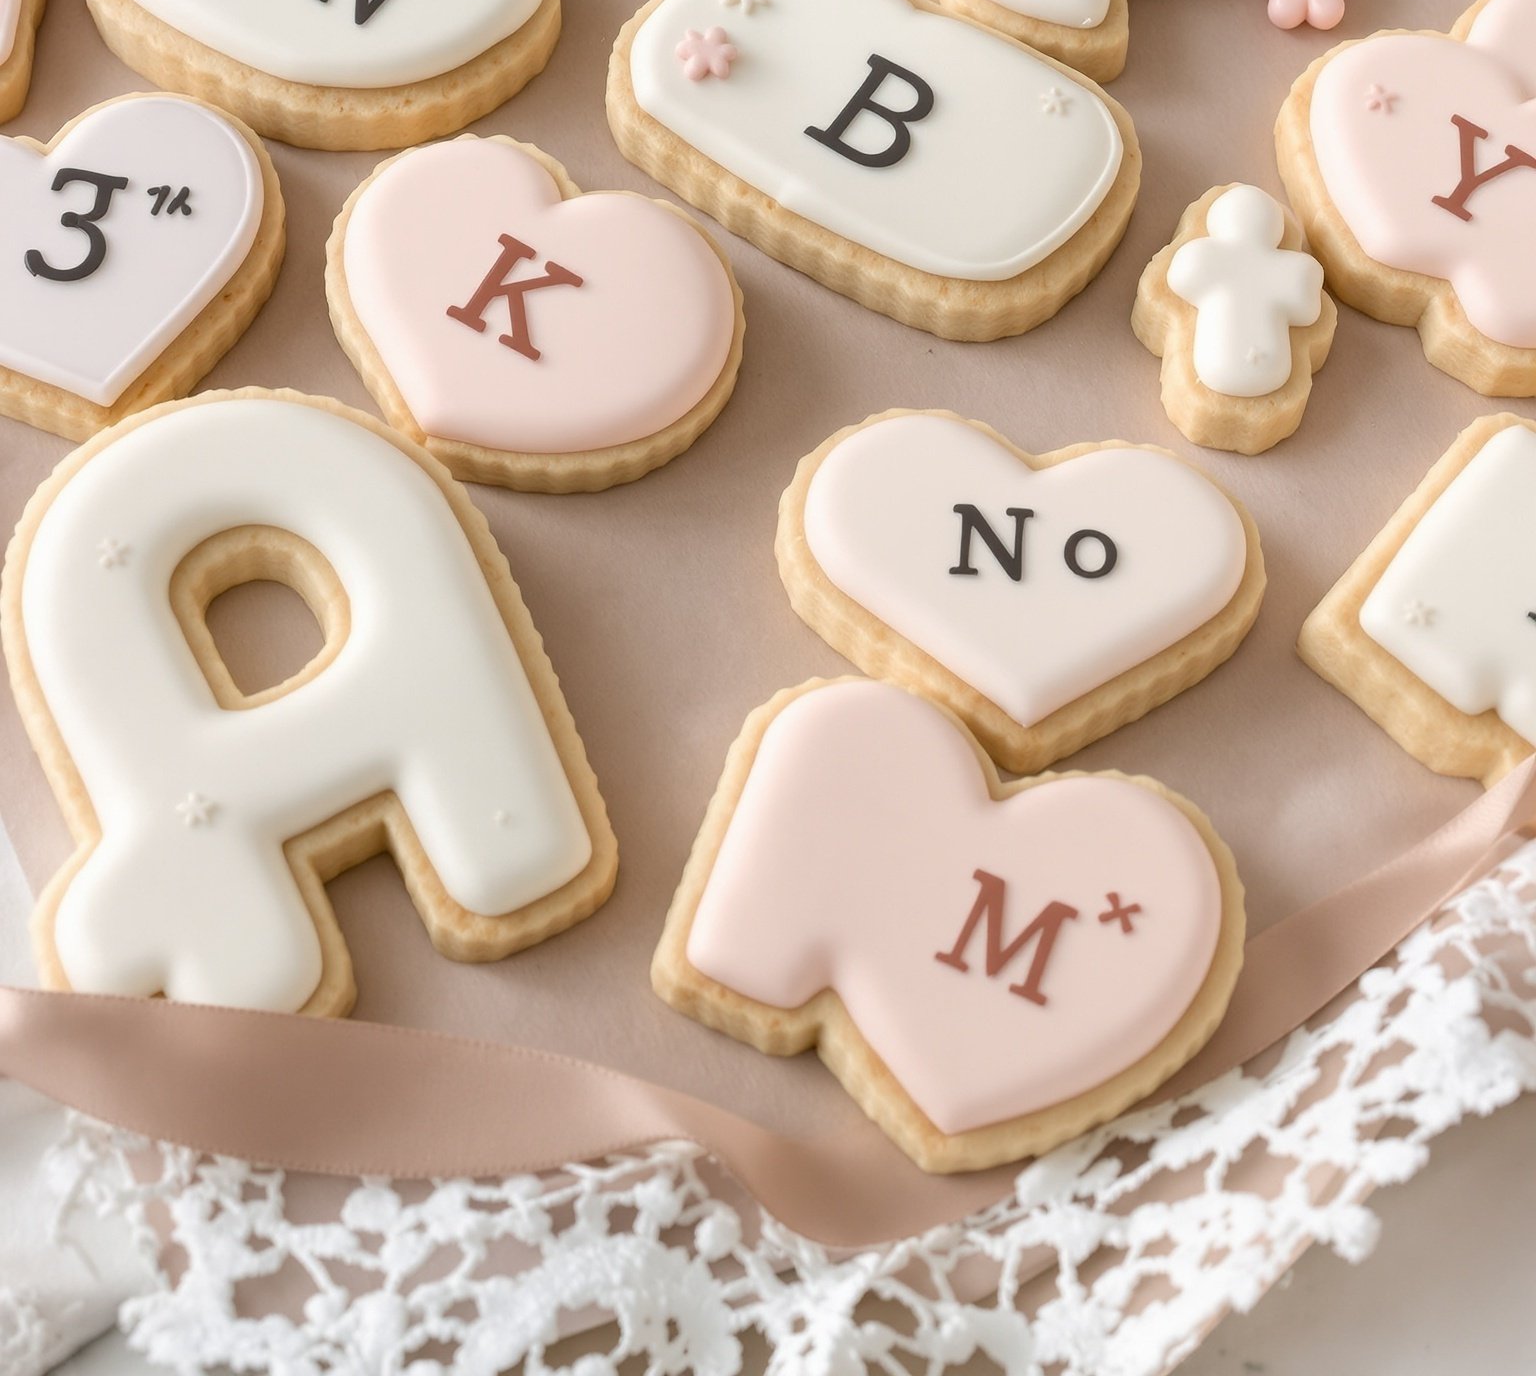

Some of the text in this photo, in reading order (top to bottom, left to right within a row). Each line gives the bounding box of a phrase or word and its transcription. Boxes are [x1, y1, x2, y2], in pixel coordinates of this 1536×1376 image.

[804, 54, 935, 169] B
[1431, 114, 1536, 222] Y
[446, 233, 584, 362] K
